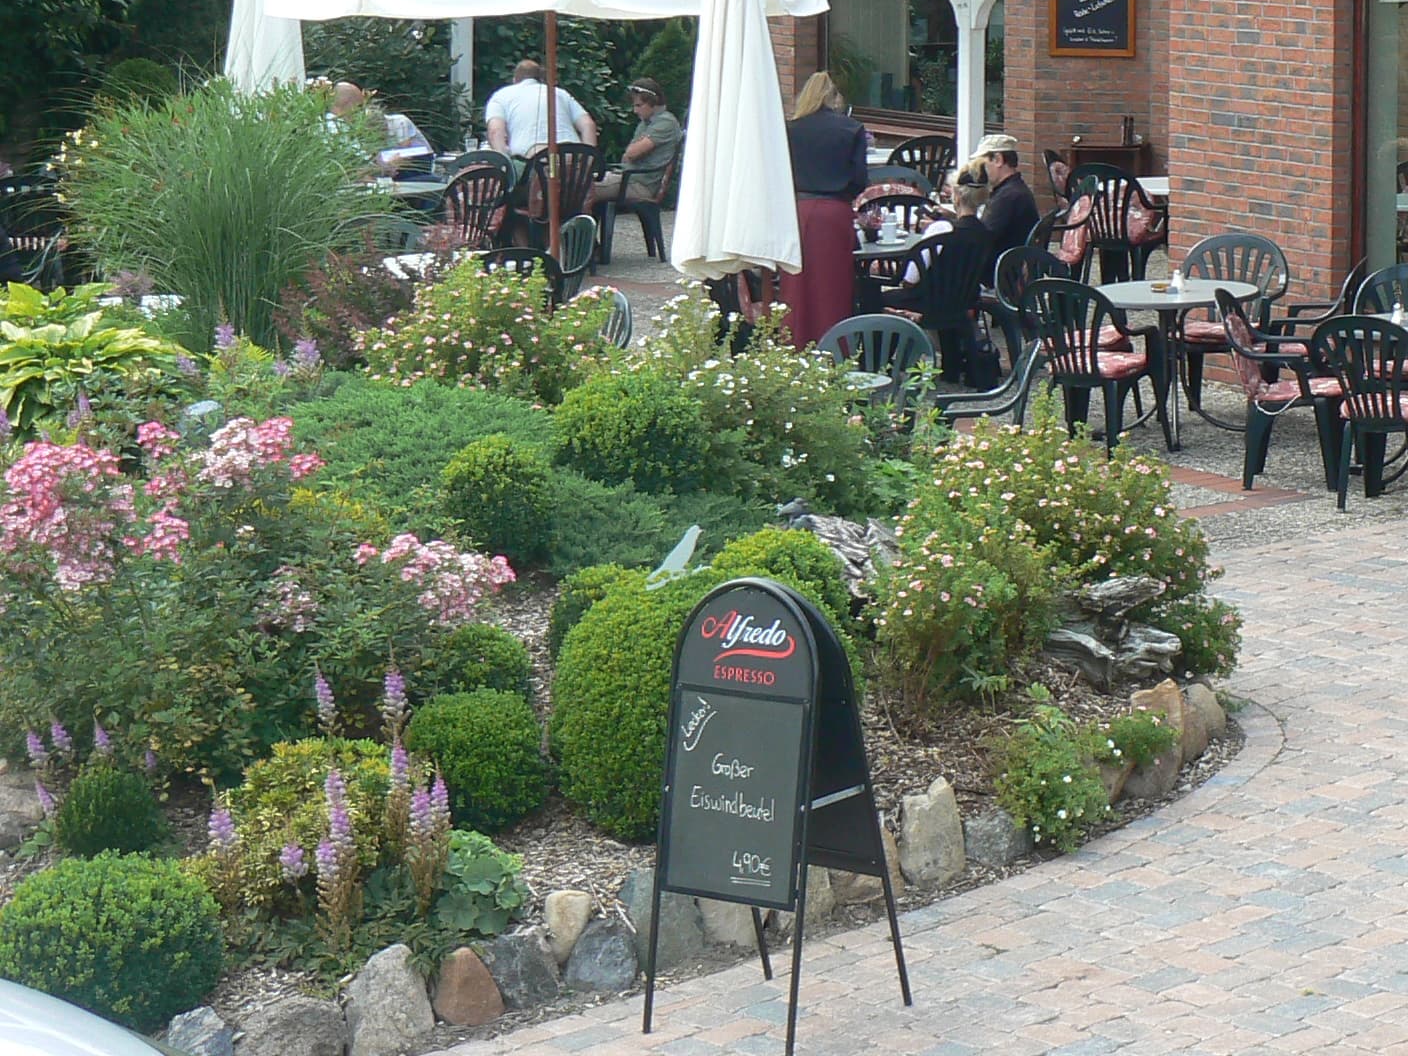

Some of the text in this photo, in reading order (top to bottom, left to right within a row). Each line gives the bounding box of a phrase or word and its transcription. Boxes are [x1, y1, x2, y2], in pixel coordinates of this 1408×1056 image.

[701, 609, 787, 649] Alfredo
[713, 664, 776, 685] ESPRESSO
[711, 752, 755, 780] Großer
[690, 785, 775, 822] Eiswindbeutel
